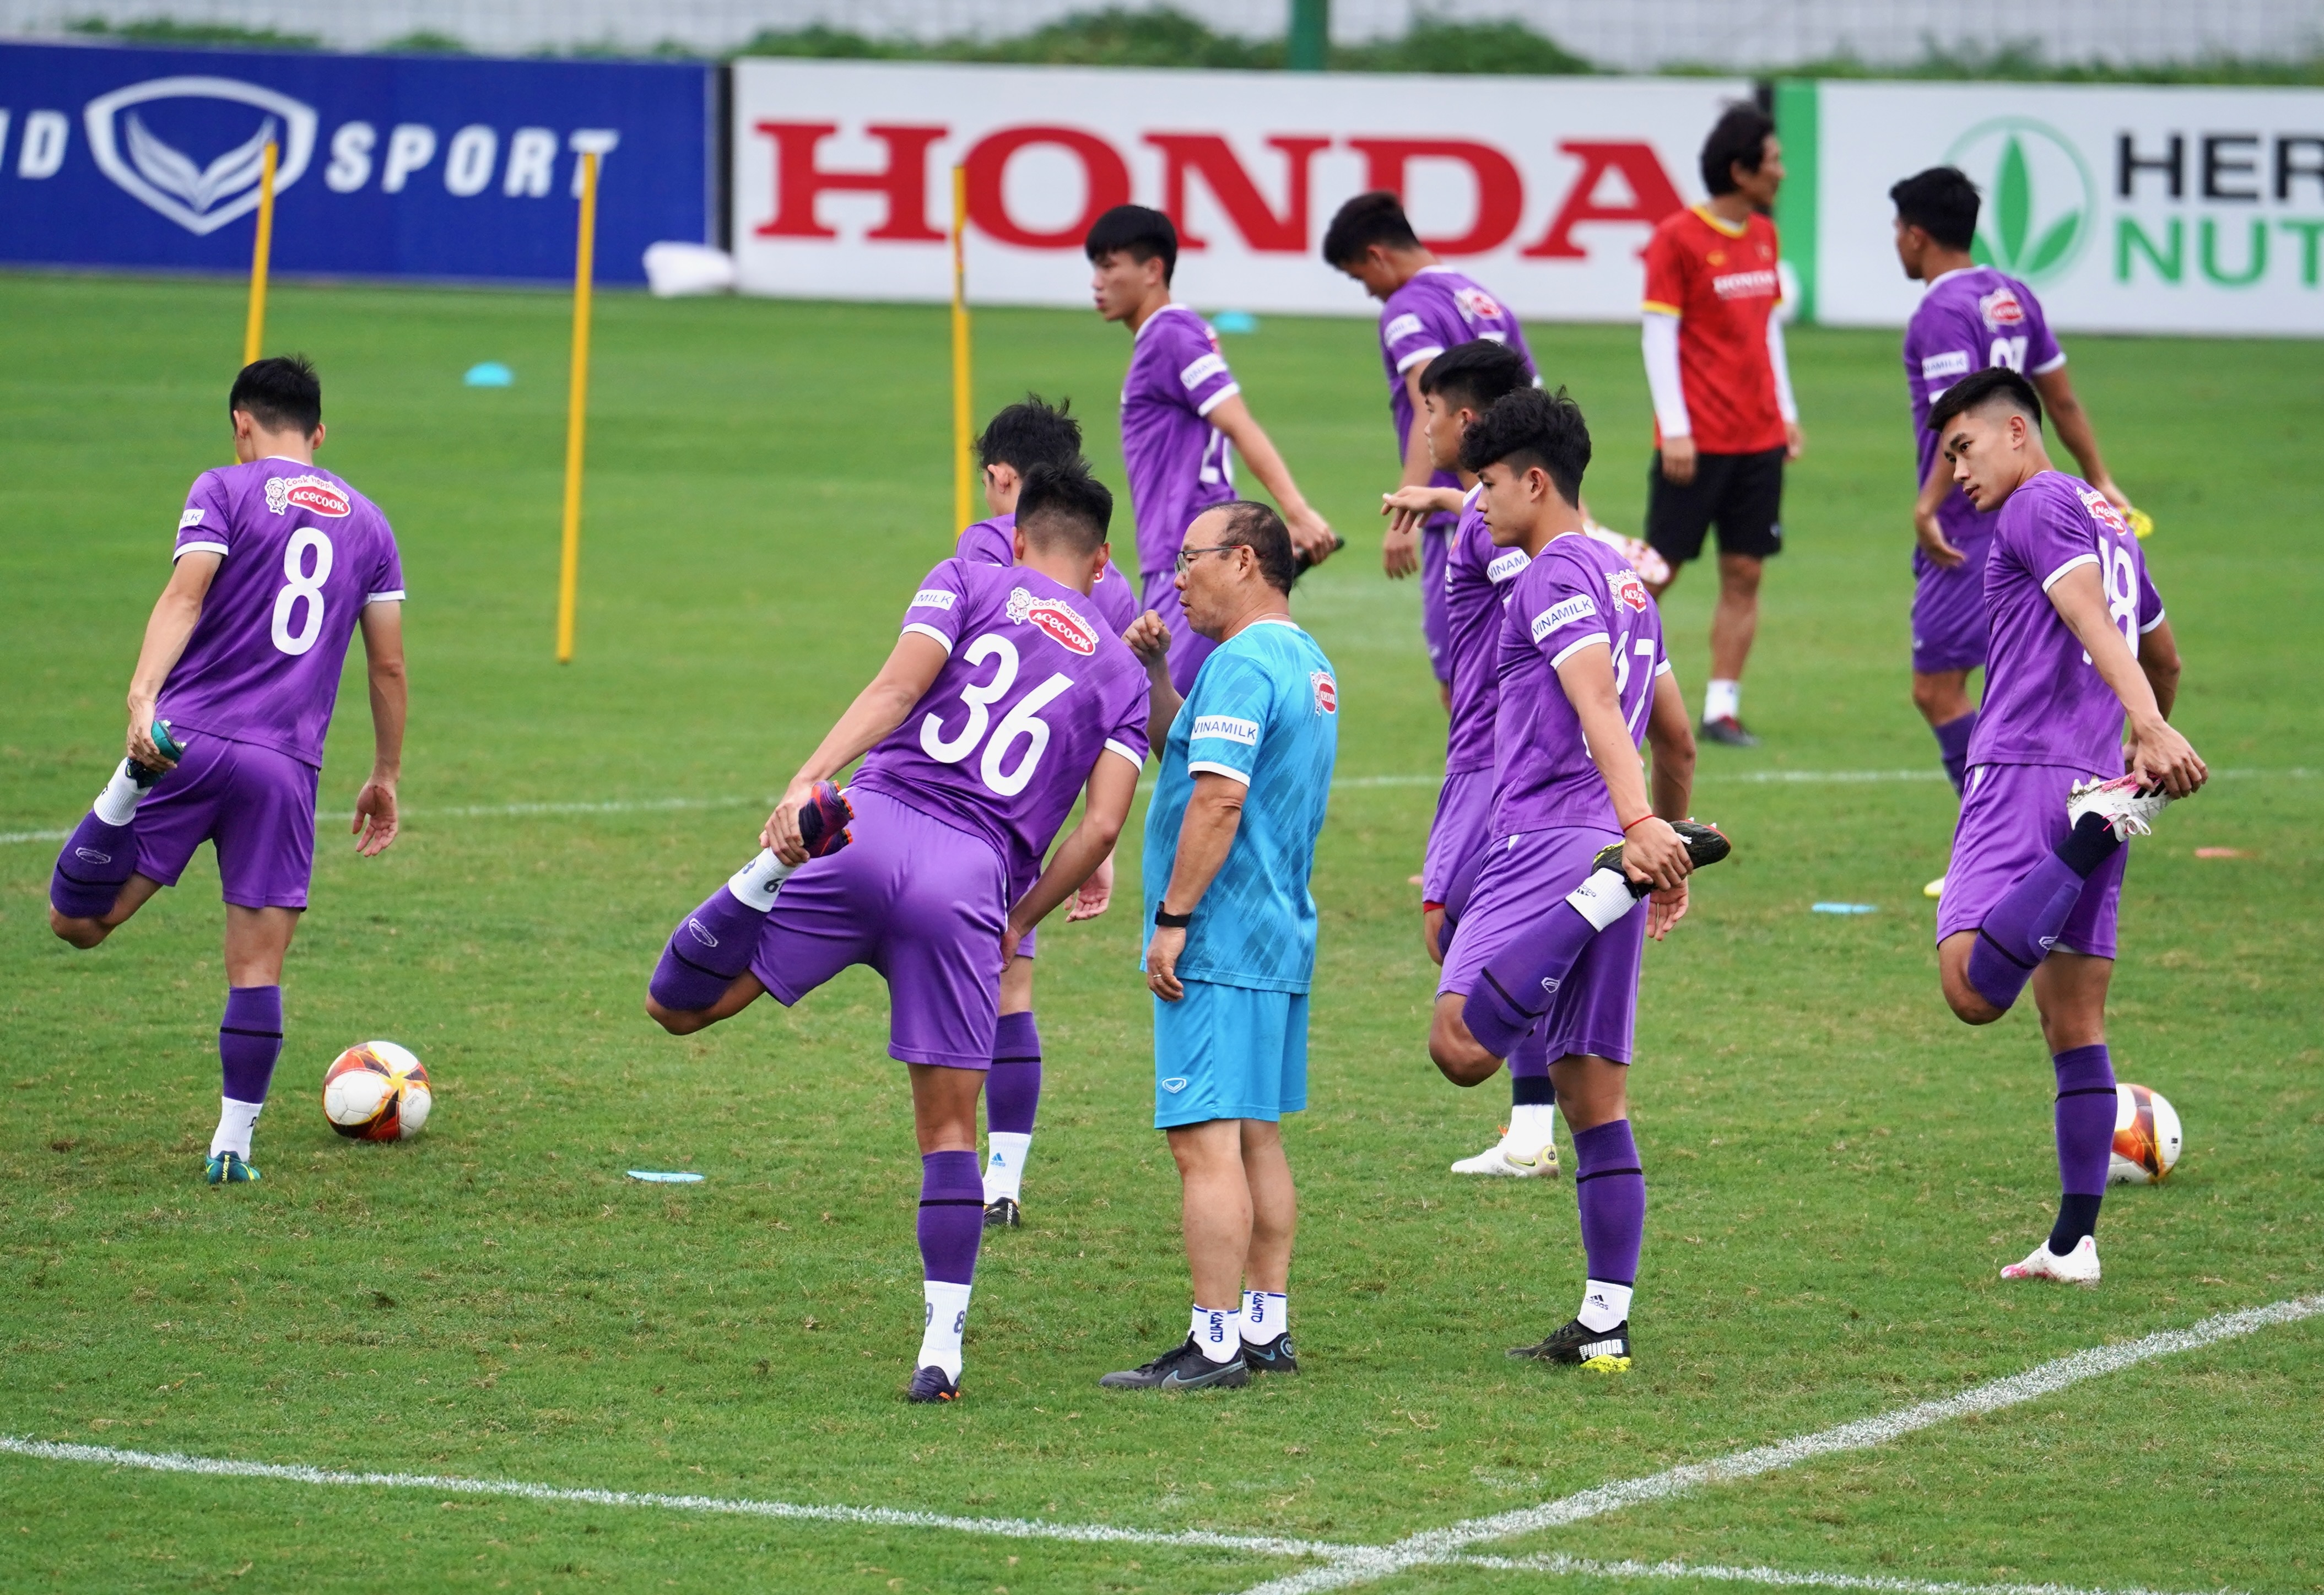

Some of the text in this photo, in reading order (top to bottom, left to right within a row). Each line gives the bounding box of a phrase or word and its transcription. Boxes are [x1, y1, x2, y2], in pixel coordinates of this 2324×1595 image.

[324, 120, 620, 199] SPORT
[754, 121, 1686, 258] HONDA
[286, 477, 348, 500] Cook happiness
[272, 527, 333, 656] 8
[1032, 599, 1098, 641] Cook happiness
[1532, 599, 1593, 635] VINAMILK
[920, 633, 1075, 797] 36
[1194, 721, 1256, 739] VINAMILK
[1251, 1293, 1264, 1322] KAMITO
[1585, 1298, 1609, 1310] adidas
[1210, 1312, 1223, 1342] KAMITO
[1579, 1339, 1623, 1361] PUMA
